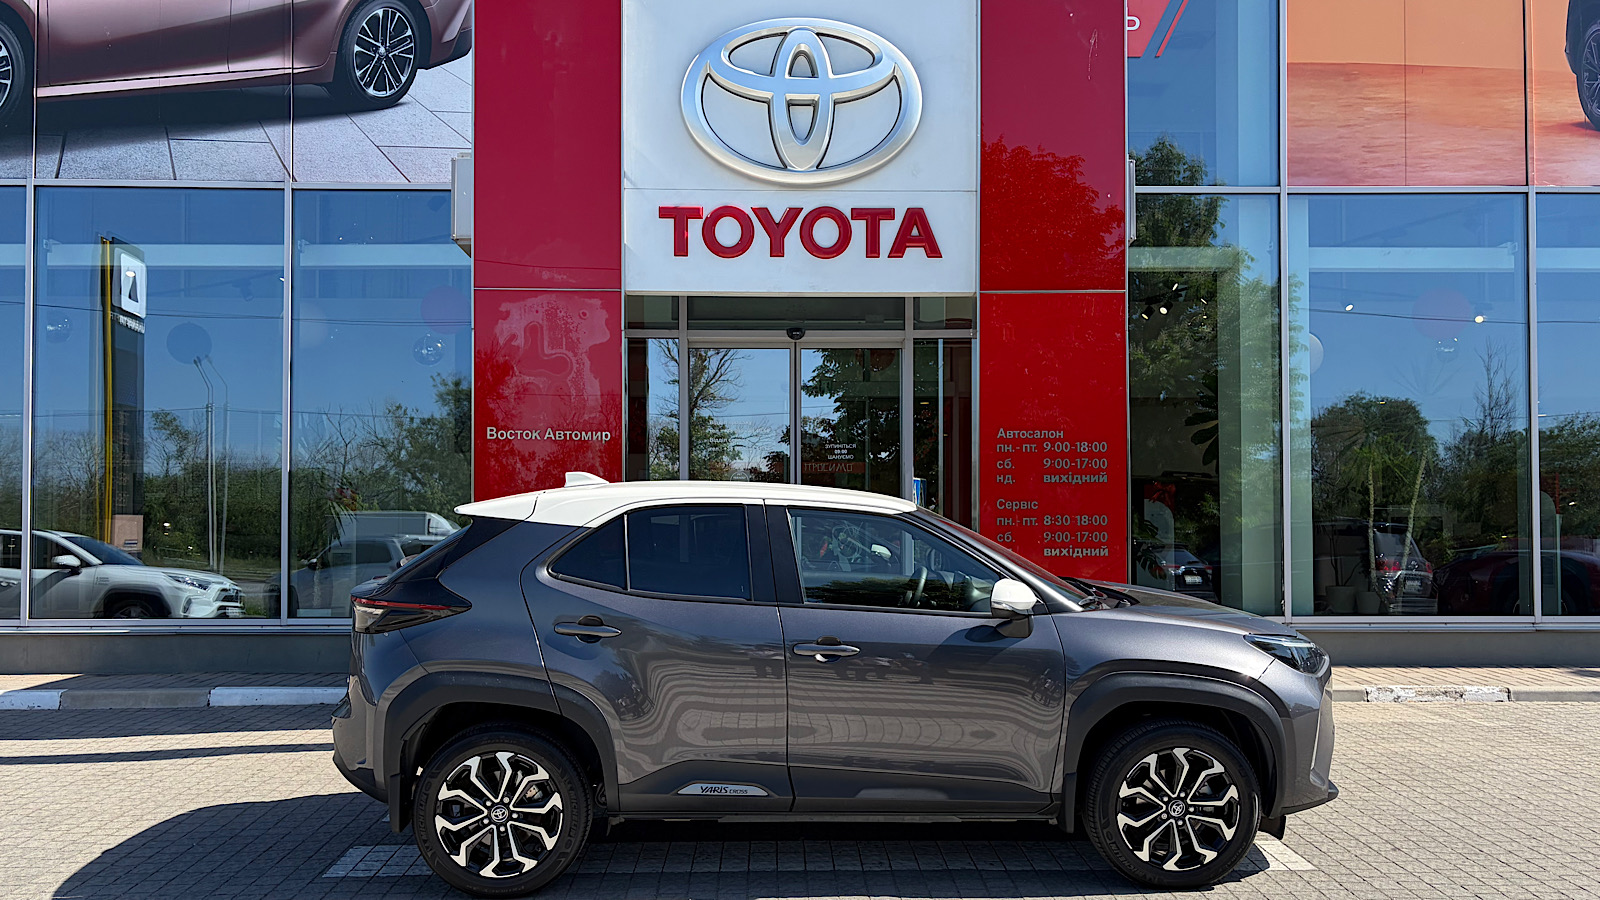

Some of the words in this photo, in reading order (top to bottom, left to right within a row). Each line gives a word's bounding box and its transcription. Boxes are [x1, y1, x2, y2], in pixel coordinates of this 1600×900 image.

[658, 205, 943, 259] TOYOTA
[486, 427, 541, 440] Восток
[544, 428, 611, 444] Автомир
[997, 428, 1064, 439] Автосалон
[804, 463, 853, 472] ПРОСИМО
[1043, 472, 1108, 485] вихідний
[996, 499, 1039, 511] Сервіс
[1043, 545, 1109, 558] вихідний
[700, 785, 729, 794] YARIS
